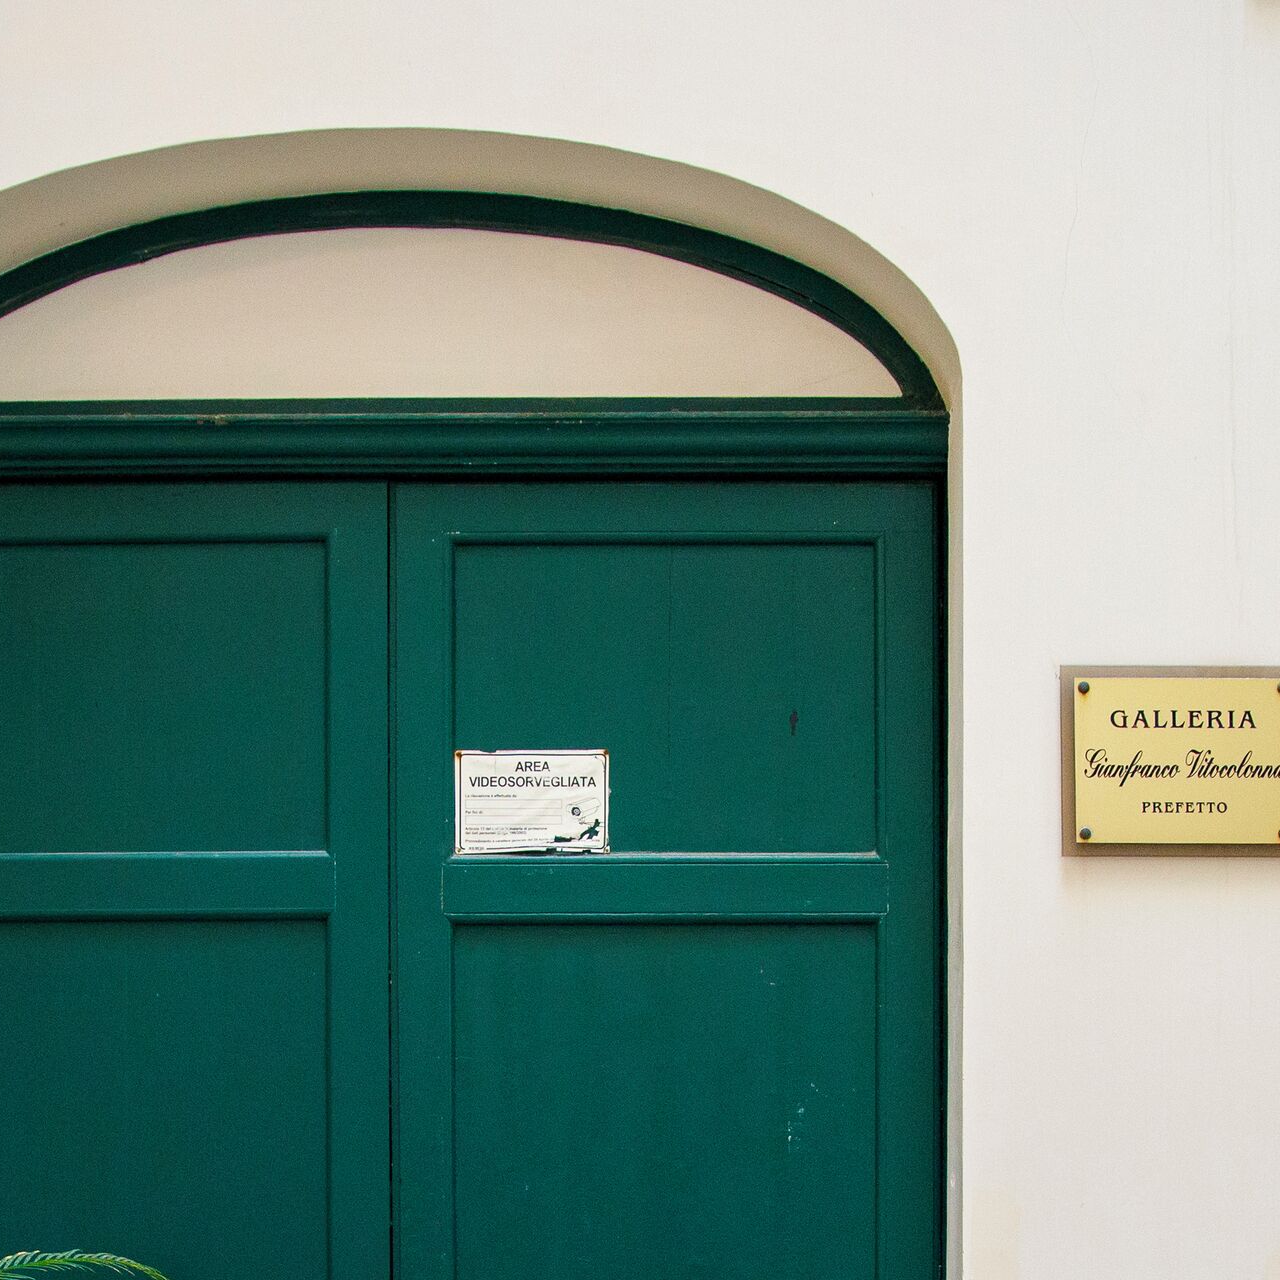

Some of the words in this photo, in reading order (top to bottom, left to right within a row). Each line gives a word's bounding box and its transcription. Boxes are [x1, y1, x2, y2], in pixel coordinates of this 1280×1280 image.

[1110, 710, 1257, 729] GALLERIA
[515, 761, 550, 772] AREA
[1084, 749, 1180, 787] Gianfranco
[469, 776, 597, 788] VIDEOSORVEGLIATA
[1142, 802, 1228, 814] PREFETTO
